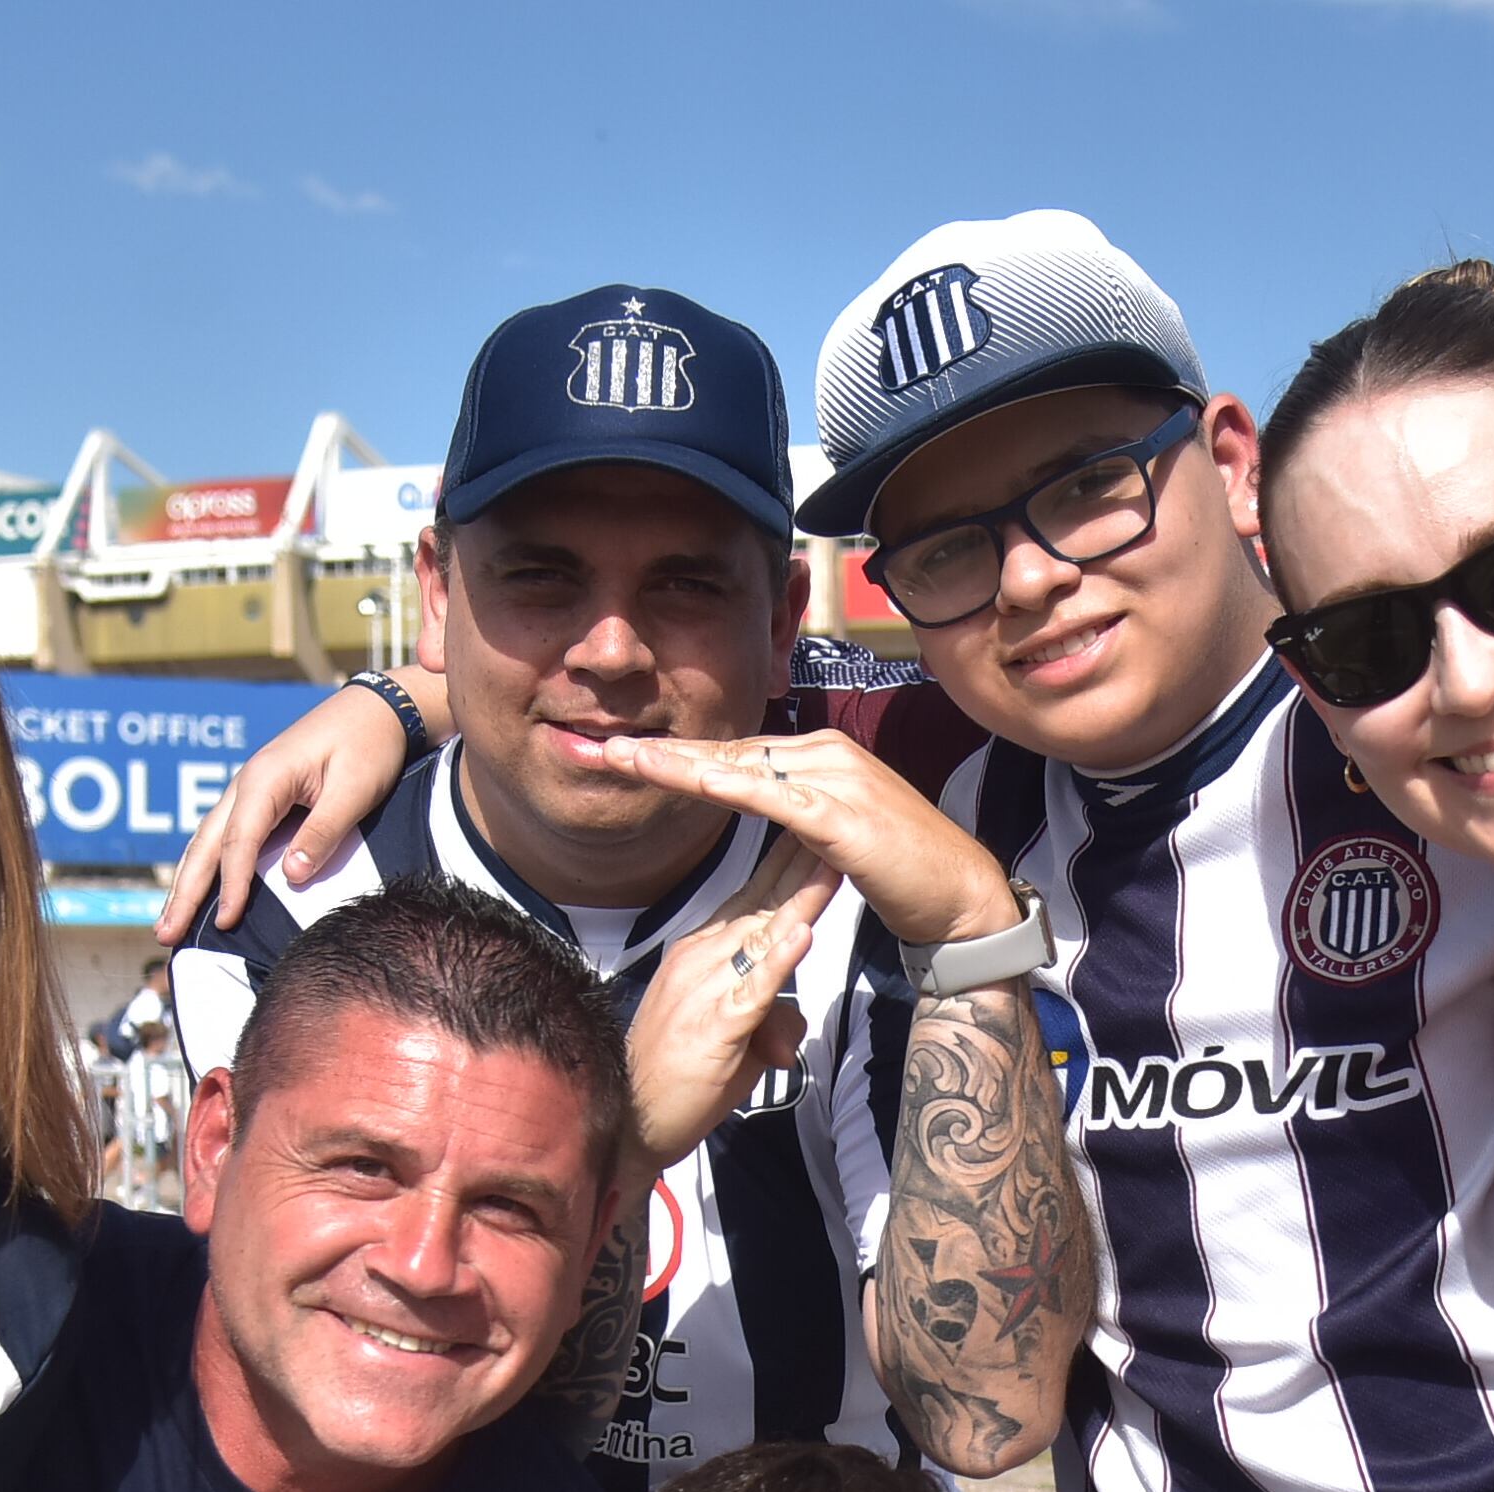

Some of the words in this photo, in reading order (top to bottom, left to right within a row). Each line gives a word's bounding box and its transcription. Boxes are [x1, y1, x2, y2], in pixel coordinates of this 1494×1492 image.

[893, 270, 945, 310] C.A.T
[117, 711, 246, 749] OFFICE
[15, 754, 247, 834] BOLE
[1343, 845, 1424, 901] ATLETICO
[1309, 947, 1405, 977] TALLERES
[1088, 1043, 1414, 1124] MÓVIL
